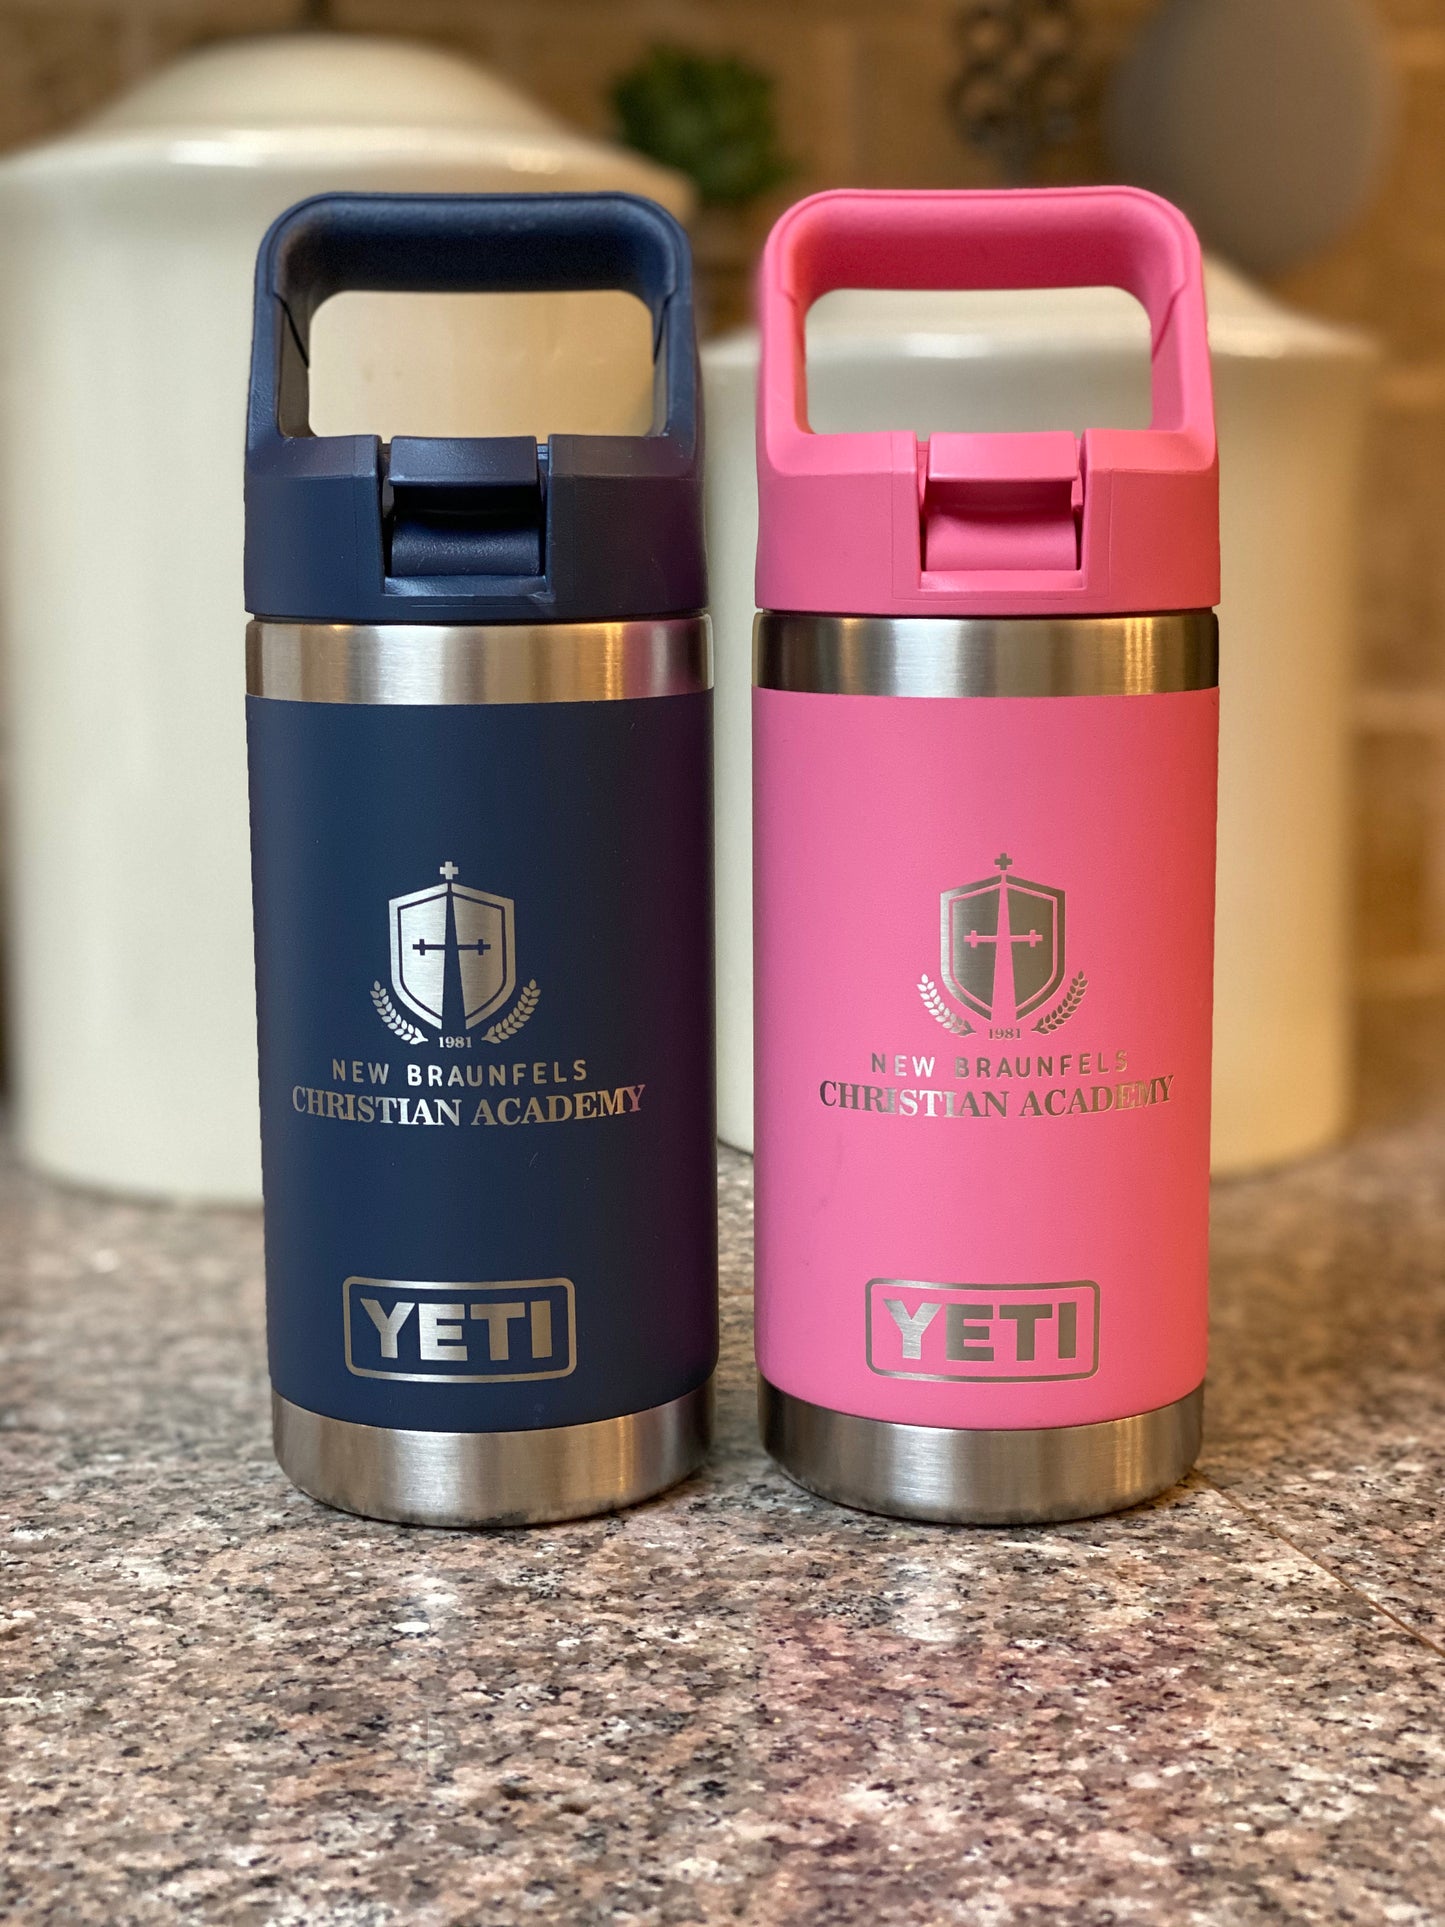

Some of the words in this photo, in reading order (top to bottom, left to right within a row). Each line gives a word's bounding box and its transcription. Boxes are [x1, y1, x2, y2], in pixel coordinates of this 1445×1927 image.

[437, 1035, 472, 1049] 1981
[987, 1027, 1022, 1040] 1981
[332, 1059, 390, 1084] NEW
[407, 1059, 587, 1087] BRAUNFELS
[871, 1052, 936, 1077] NEW
[955, 1051, 1129, 1078] BRAUNFELS
[292, 1085, 462, 1126] CHRISTIAN
[470, 1084, 646, 1126] ACADEMY
[819, 1080, 1009, 1118] CHRISTIAN
[1019, 1075, 1174, 1117] ACADEMY
[360, 1298, 553, 1361] YETI
[883, 1298, 1077, 1361] YETI
